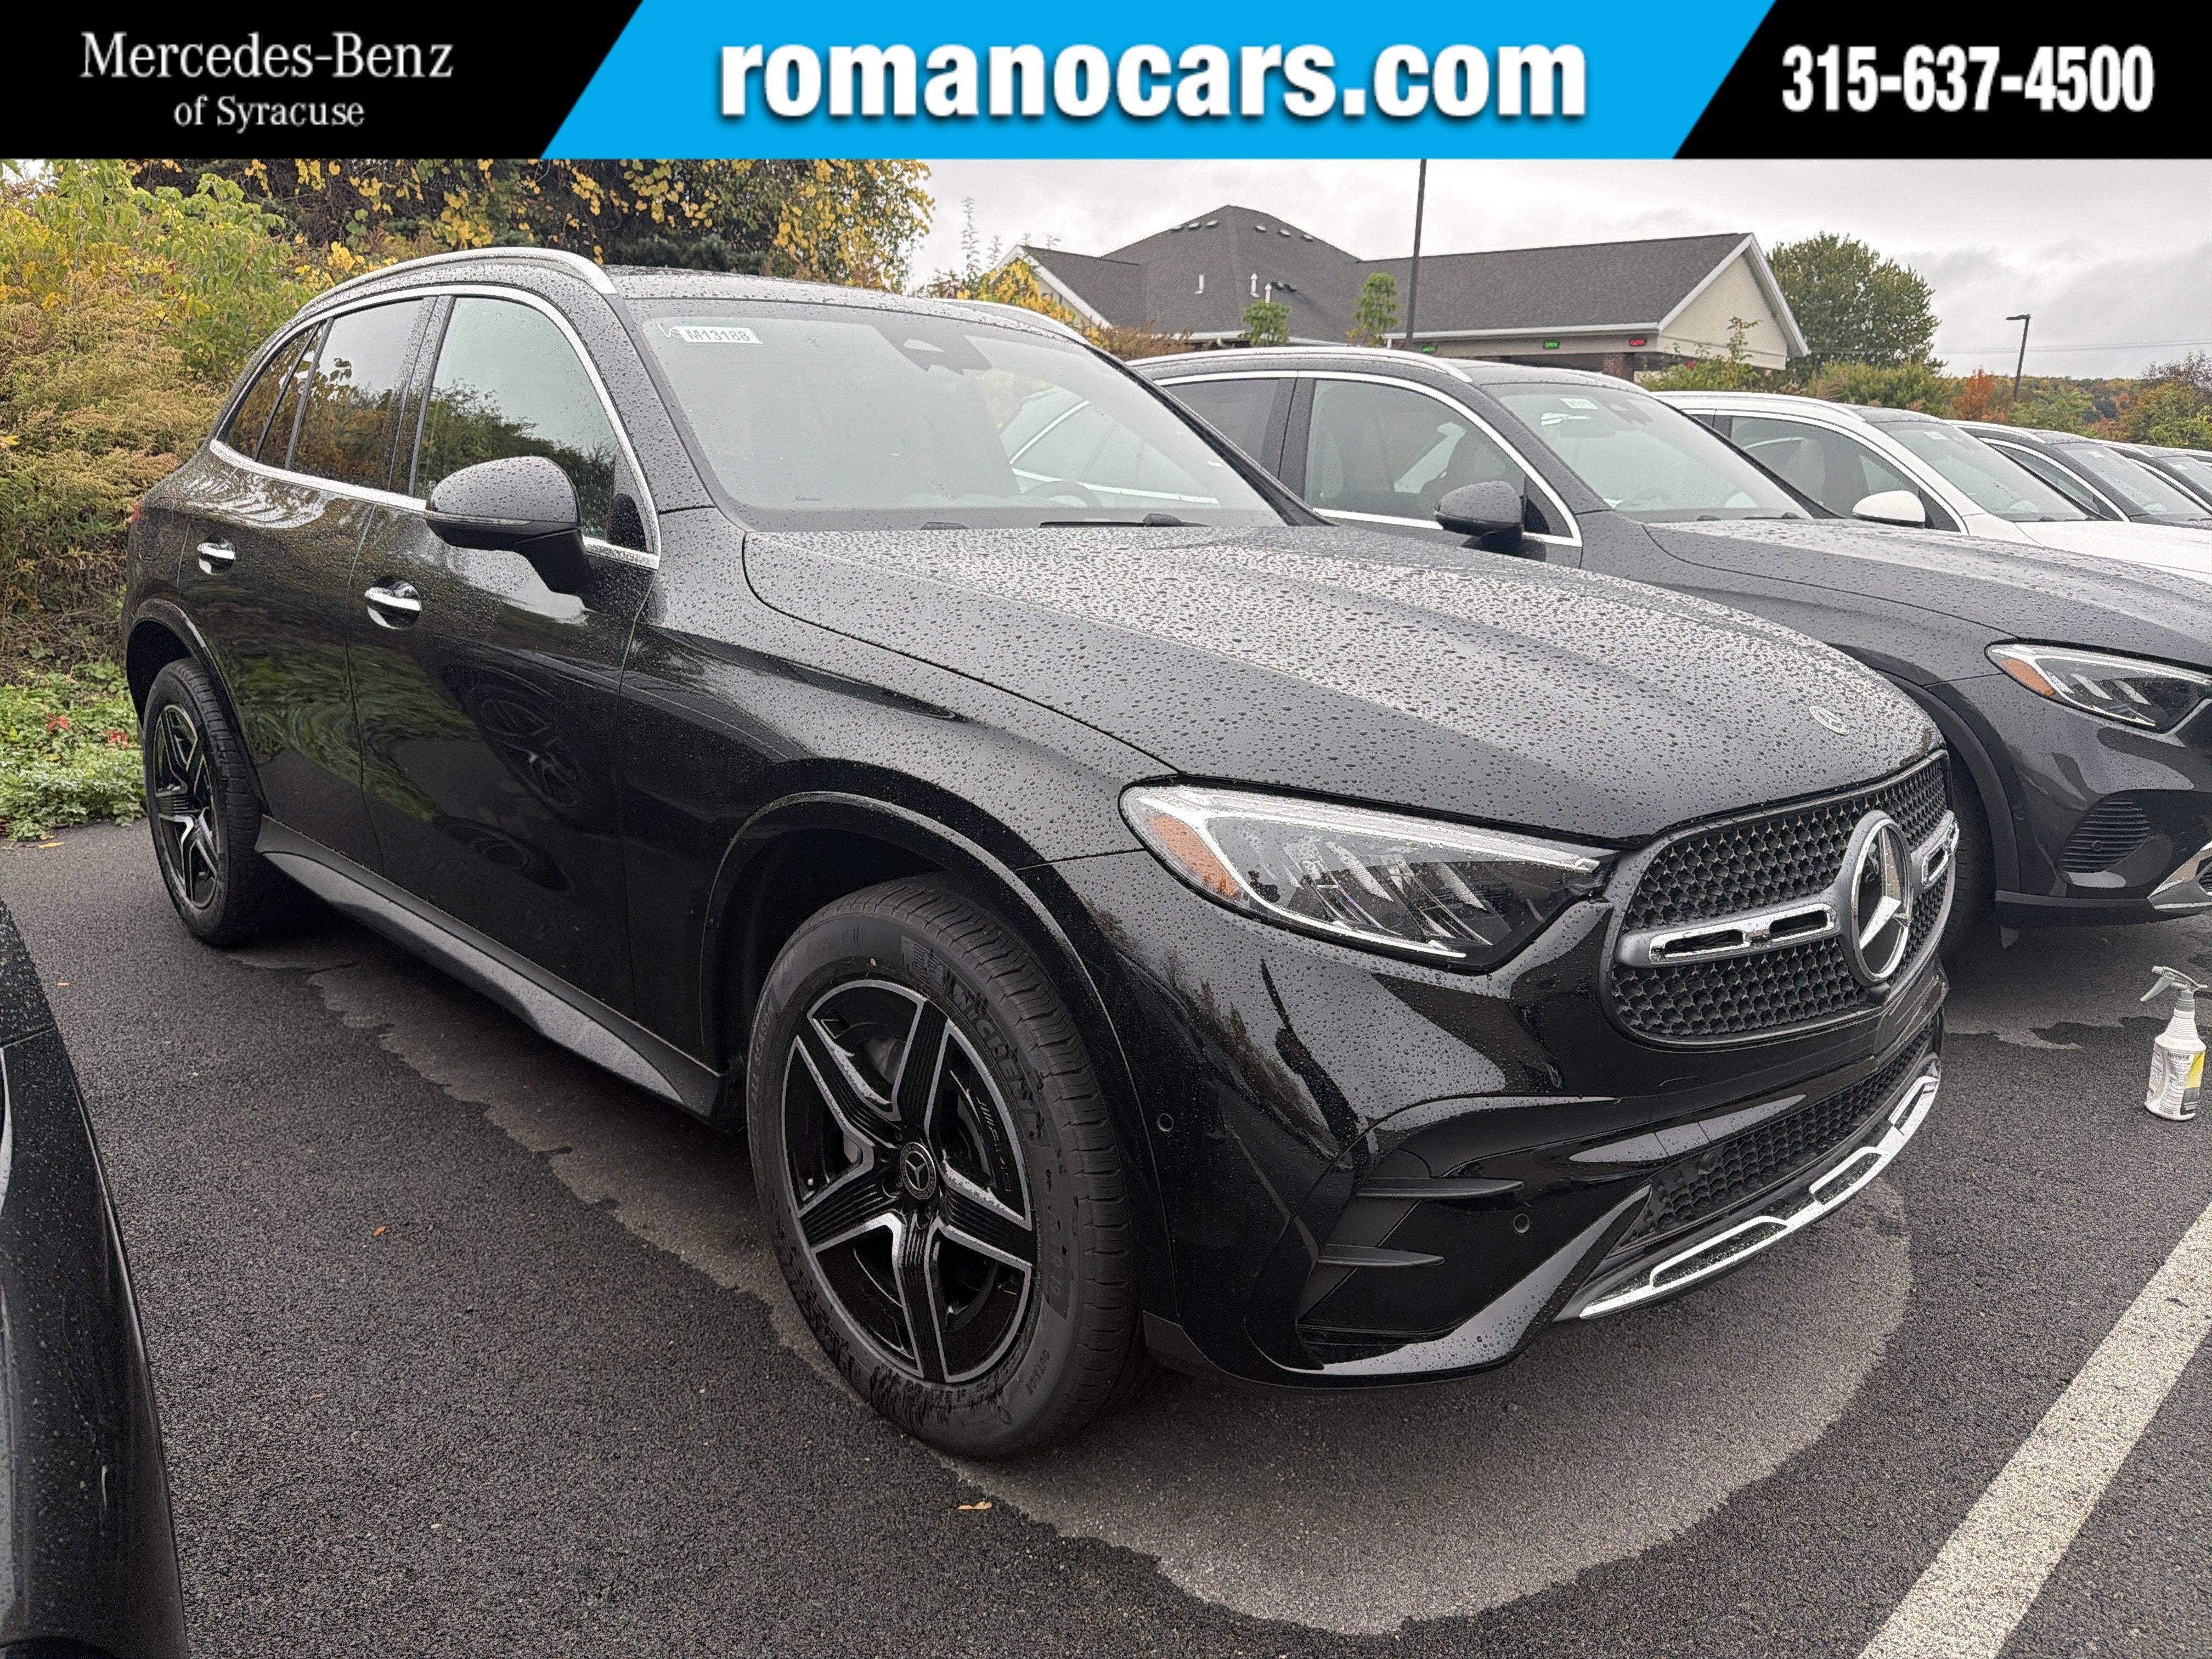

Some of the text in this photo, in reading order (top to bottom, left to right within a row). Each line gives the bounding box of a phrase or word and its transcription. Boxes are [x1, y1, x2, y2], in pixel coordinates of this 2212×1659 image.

[685, 329, 751, 341] M13188
[753, 999, 775, 1066] SEASON
[1024, 1347, 1051, 1396] OUTSIDE
